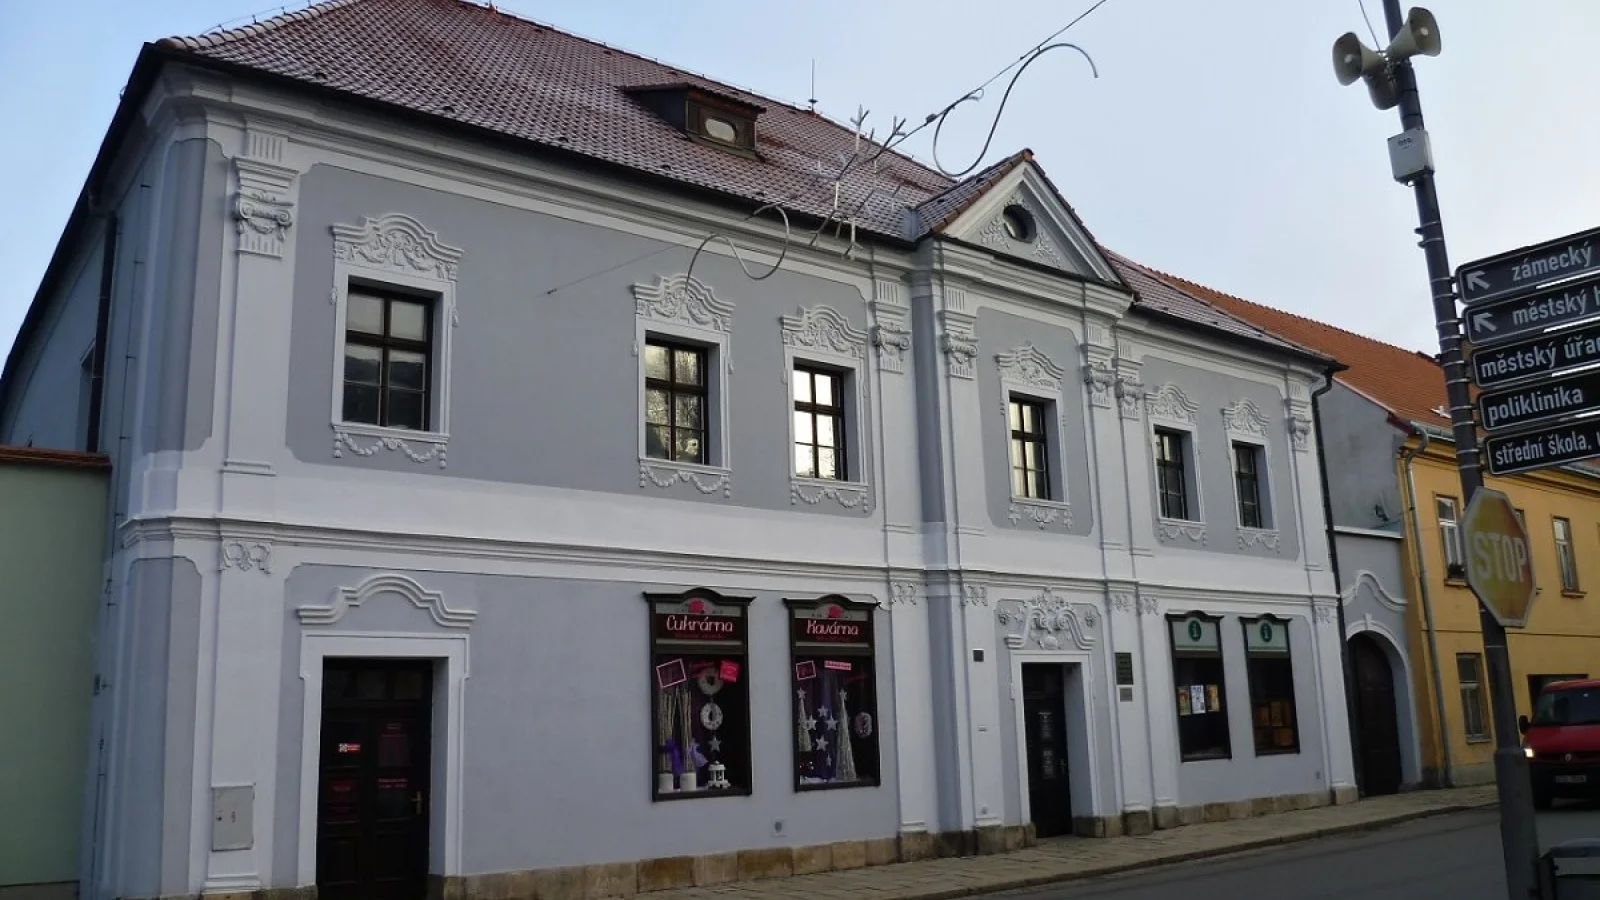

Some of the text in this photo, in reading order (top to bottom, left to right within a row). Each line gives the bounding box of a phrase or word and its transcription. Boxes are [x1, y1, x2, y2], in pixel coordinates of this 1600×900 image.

[1512, 241, 1592, 282] zámecký
[1512, 289, 1588, 325] městský
[1481, 342, 1557, 378] městský
[1488, 387, 1584, 426] poliklinika
[1495, 436, 1544, 466] střední
[1473, 531, 1527, 583] STOP
[666, 614, 733, 632] Cukrárna
[806, 619, 859, 635] Kavárna
